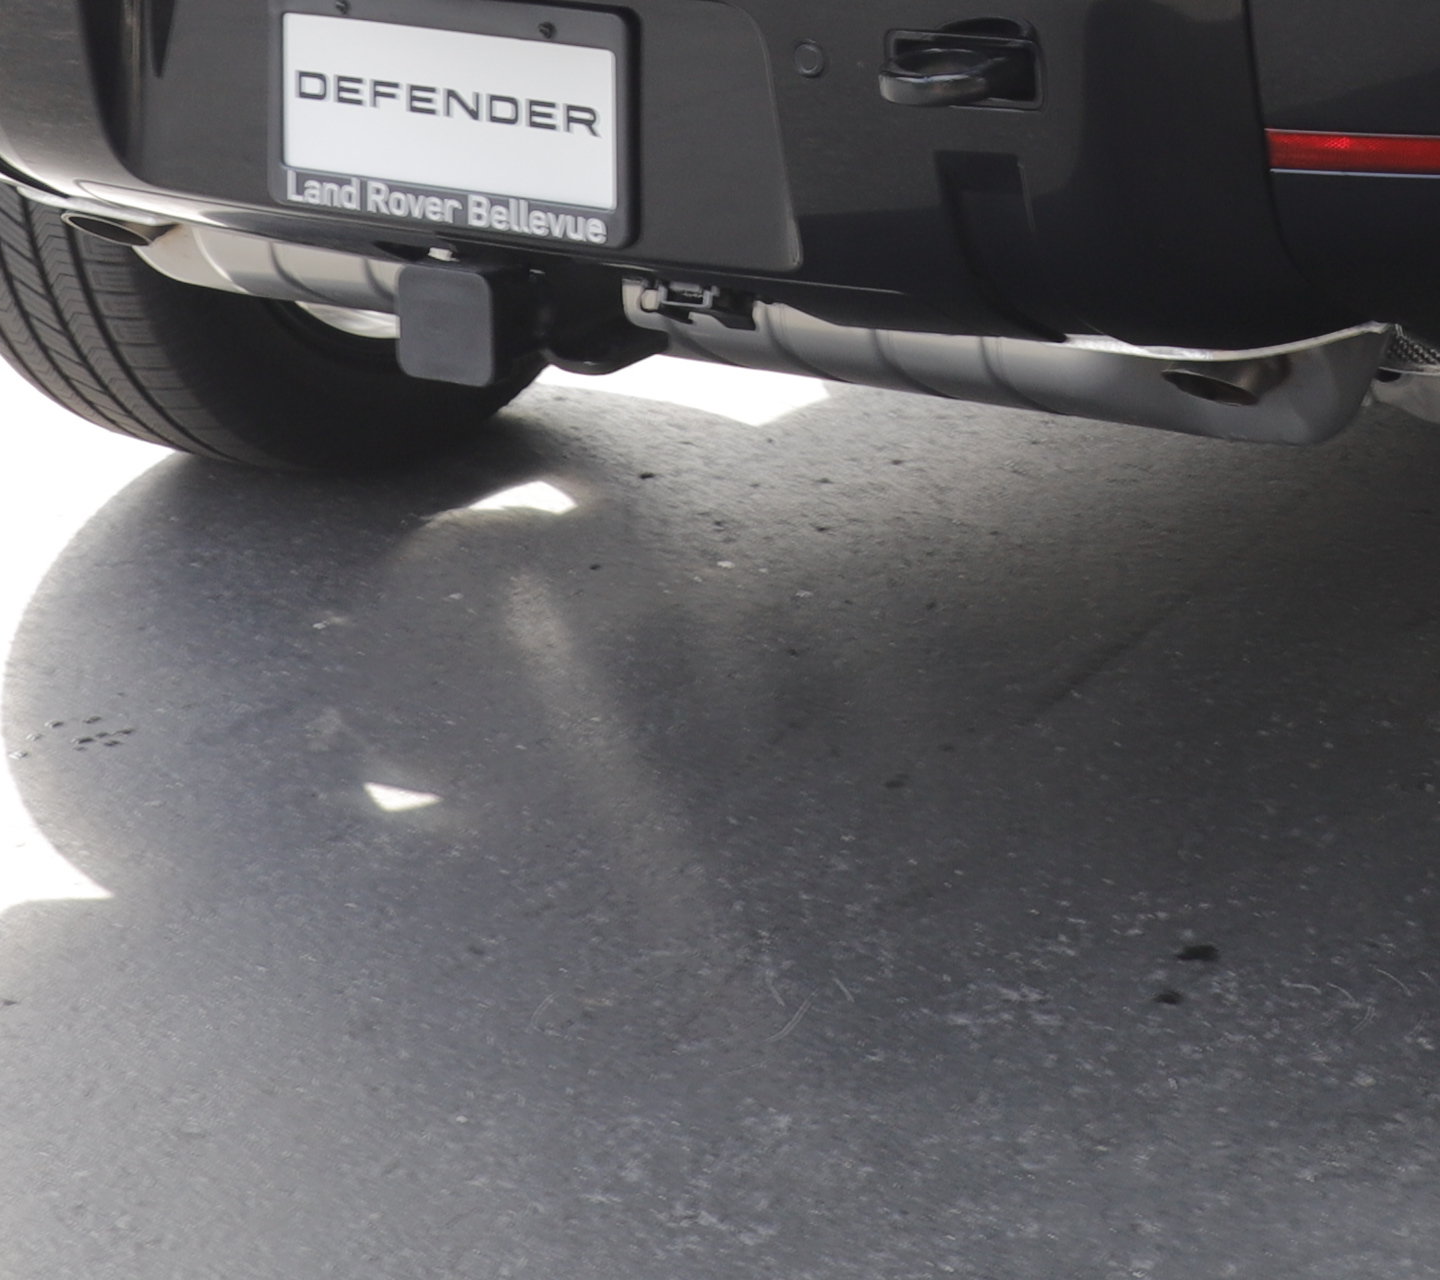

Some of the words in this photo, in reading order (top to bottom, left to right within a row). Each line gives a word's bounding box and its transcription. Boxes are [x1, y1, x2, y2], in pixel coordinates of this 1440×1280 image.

[295, 69, 603, 139] DEFENDER
[286, 169, 361, 211] Land
[366, 181, 464, 225] Rover
[467, 195, 608, 245] Bellevue
